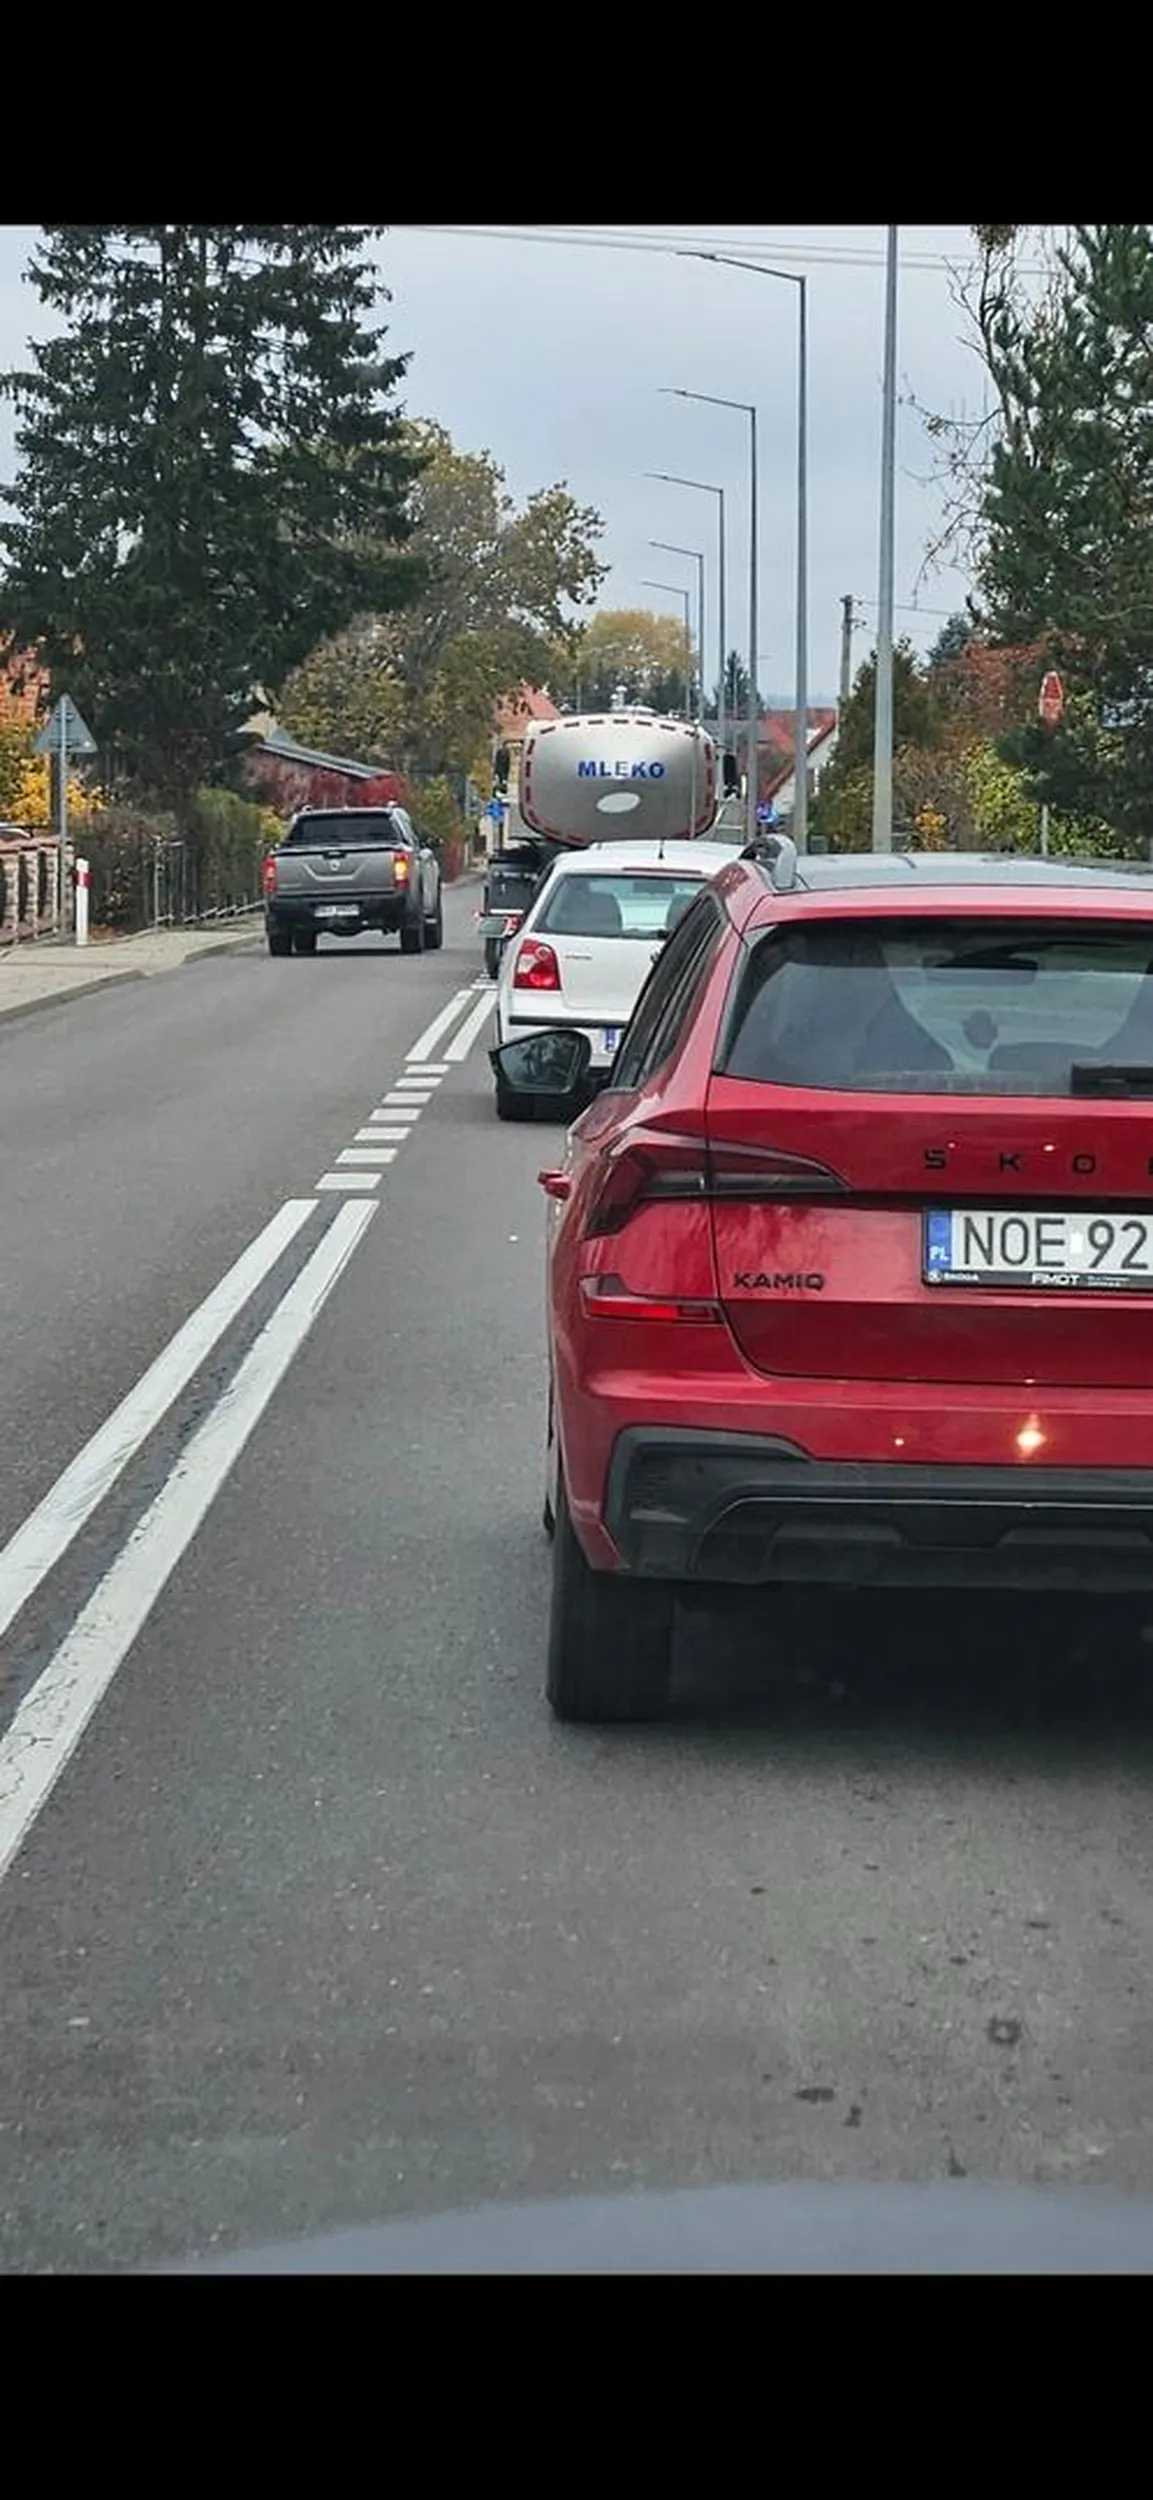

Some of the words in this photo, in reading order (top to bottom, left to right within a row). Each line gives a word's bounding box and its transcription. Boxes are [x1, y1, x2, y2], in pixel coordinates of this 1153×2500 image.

[577, 760, 666, 779] MLEKO
[963, 1215, 1066, 1268] NOE
[1087, 1218, 1149, 1270] 92
[928, 1245, 949, 1261] PL
[733, 1272, 826, 1291] KAMIQ
